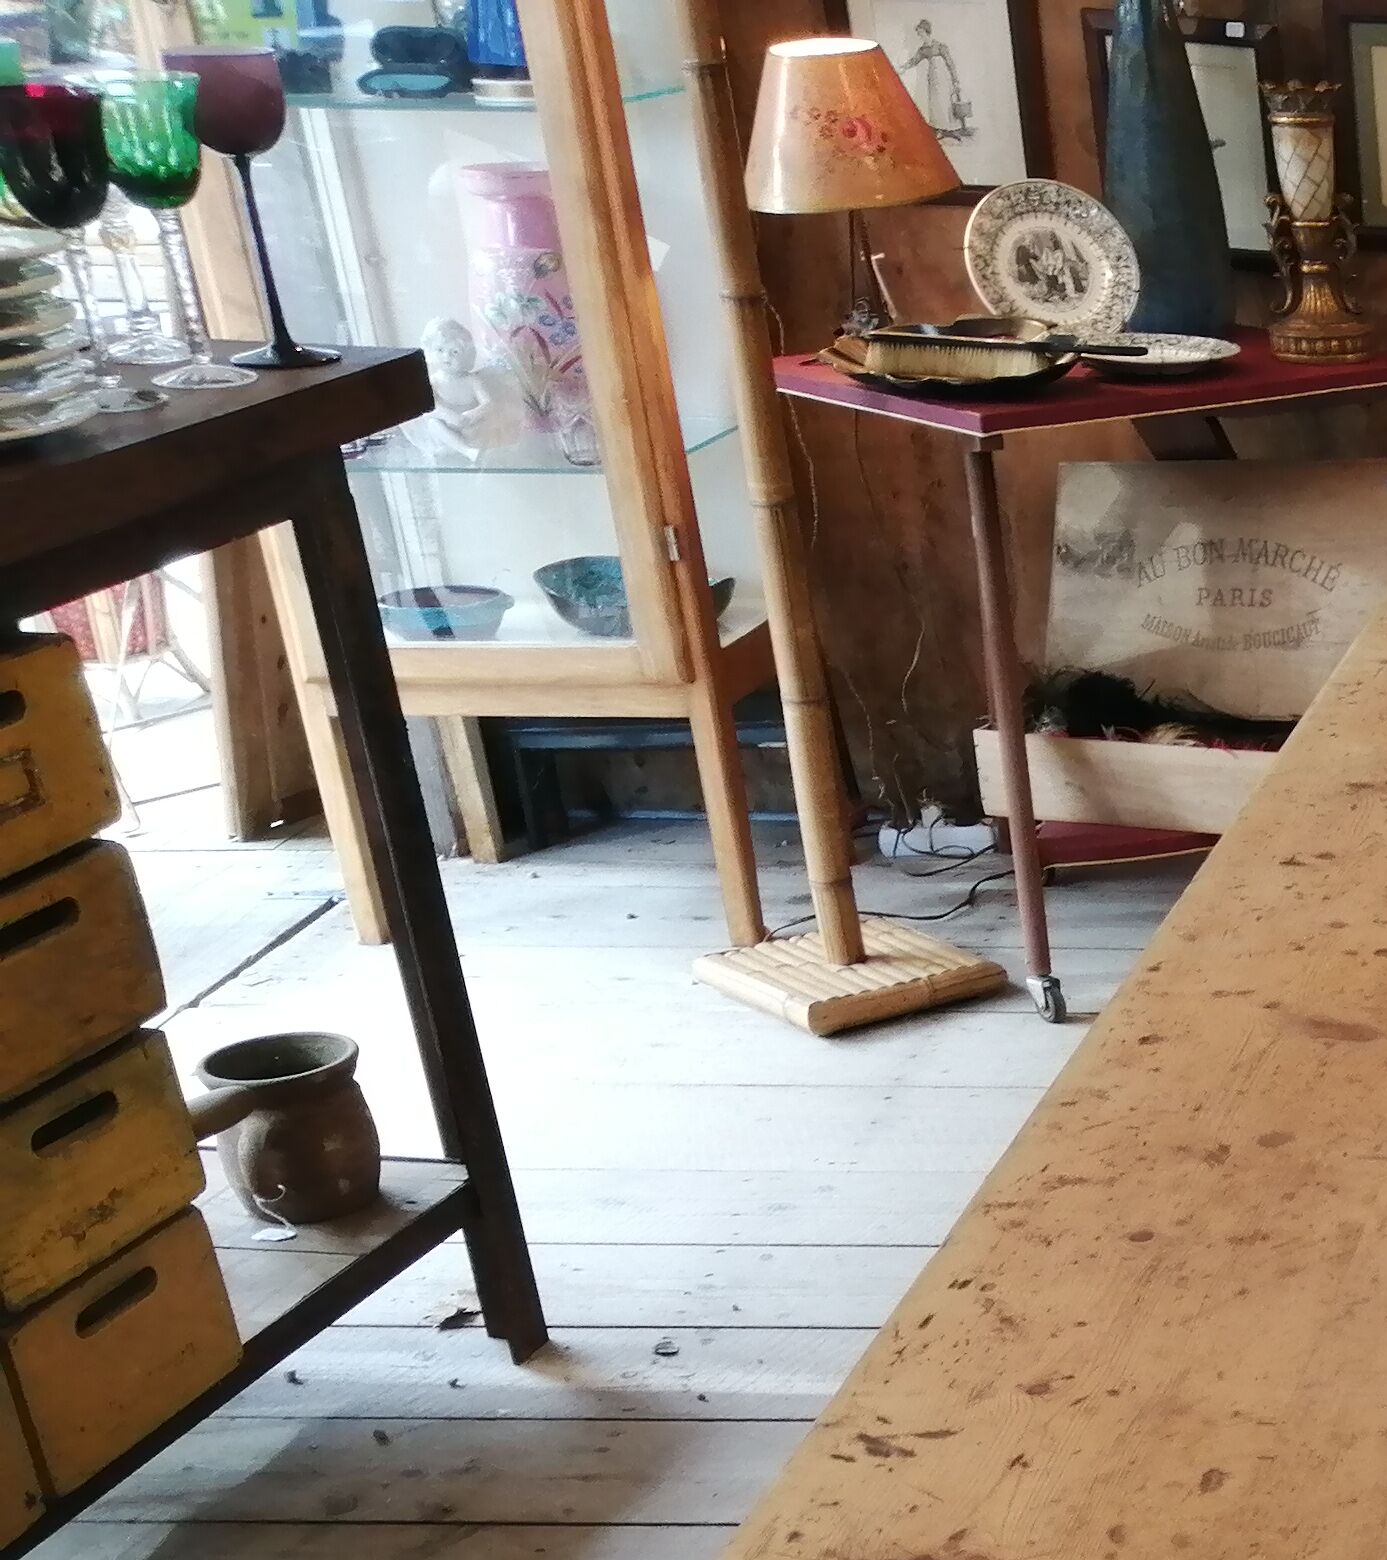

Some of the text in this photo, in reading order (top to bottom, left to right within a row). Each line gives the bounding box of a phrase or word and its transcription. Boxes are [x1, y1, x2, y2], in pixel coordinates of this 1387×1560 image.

[1136, 536, 1344, 593] AU BON MARCHÉ
[1195, 587, 1275, 608] PARIS
